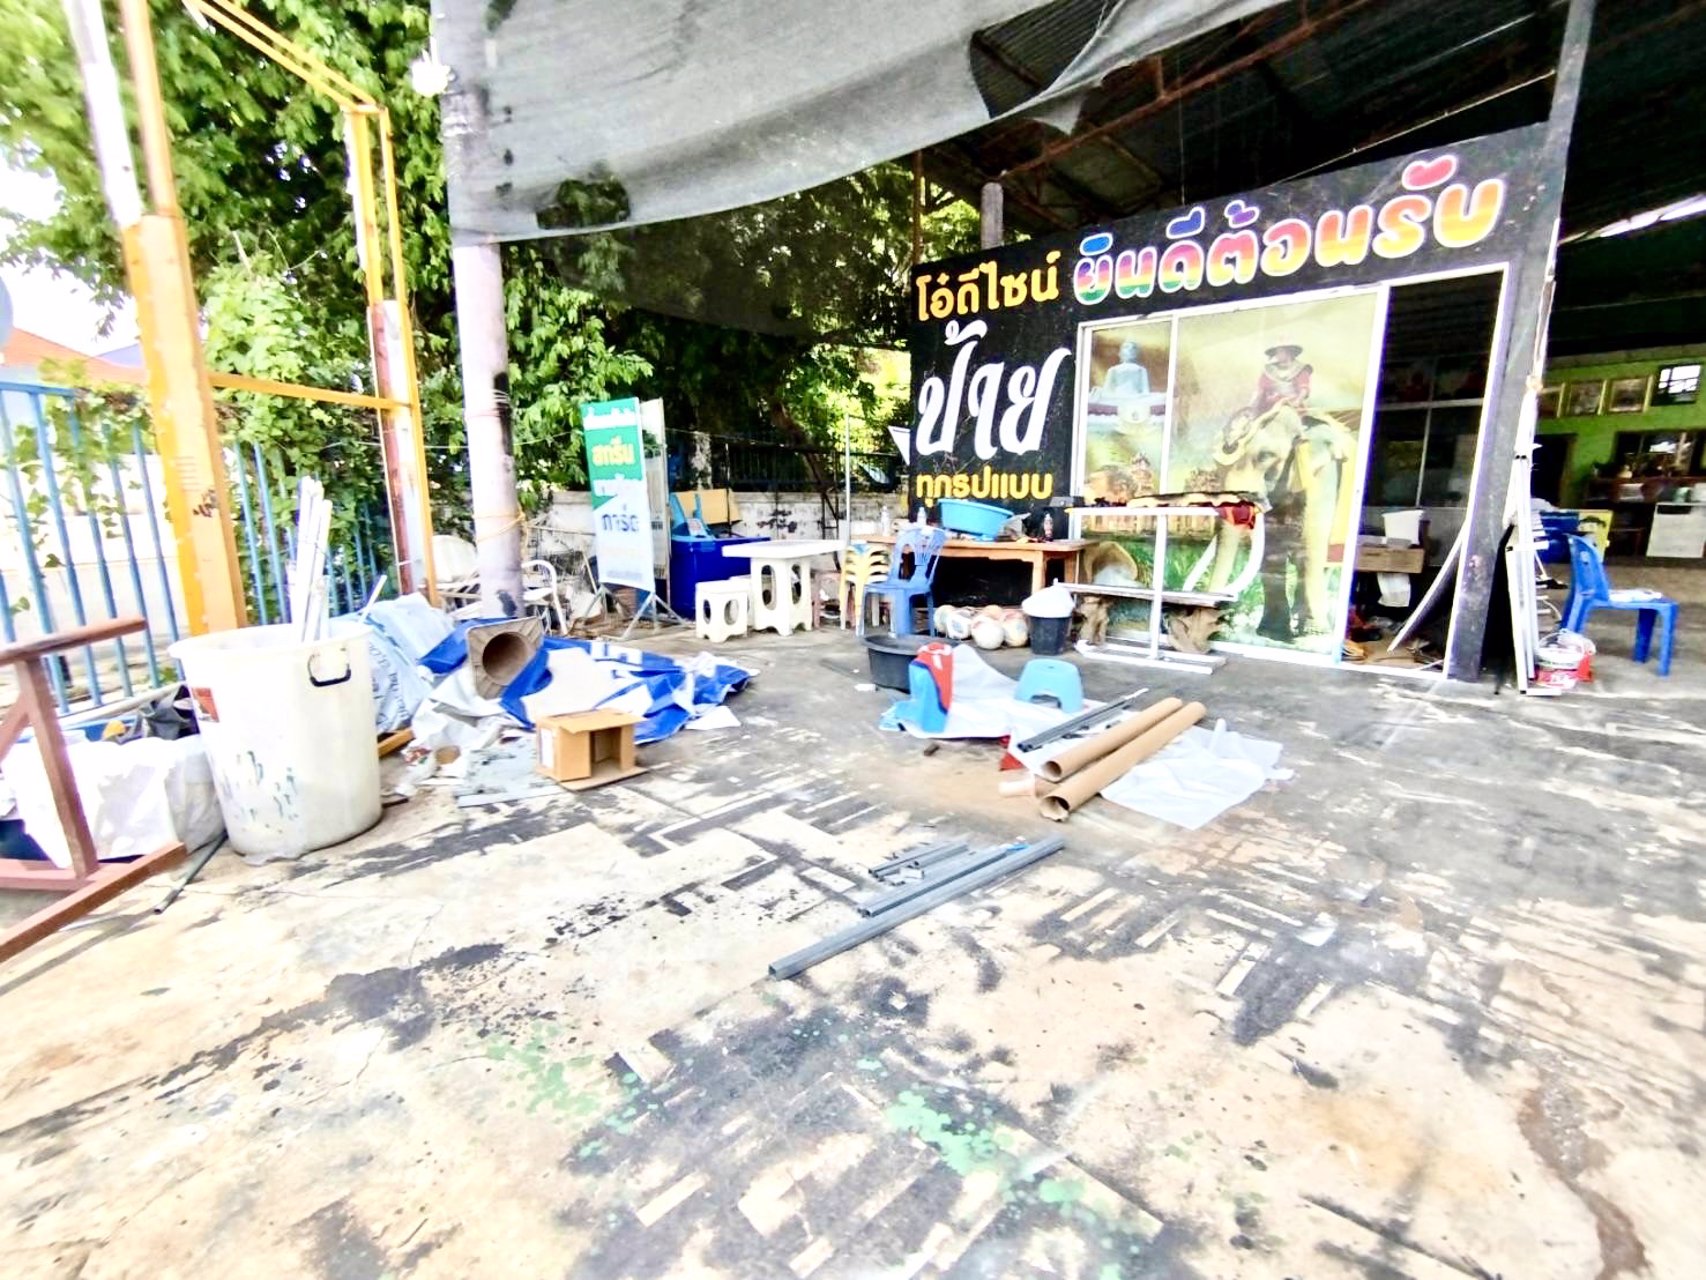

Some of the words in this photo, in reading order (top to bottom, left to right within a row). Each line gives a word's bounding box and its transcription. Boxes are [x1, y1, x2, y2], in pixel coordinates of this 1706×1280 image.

[1073, 154, 1503, 305] ยินดีต้อนรับ
[916, 319, 1072, 460] ป้าย
[916, 465, 1053, 508] ทุกรปแบบ
